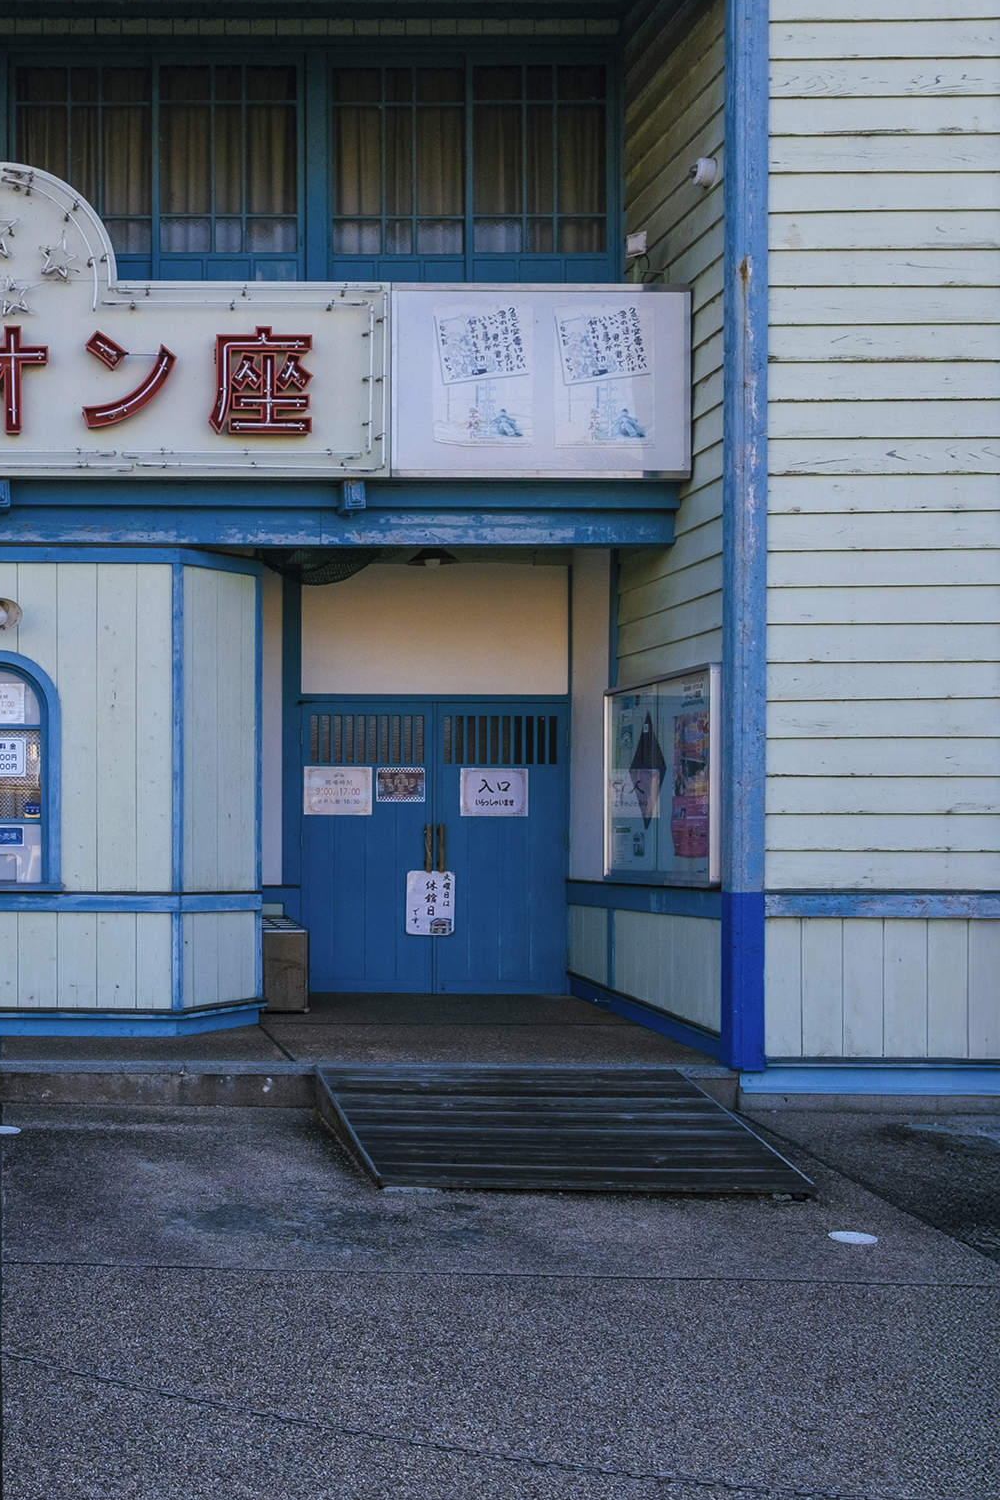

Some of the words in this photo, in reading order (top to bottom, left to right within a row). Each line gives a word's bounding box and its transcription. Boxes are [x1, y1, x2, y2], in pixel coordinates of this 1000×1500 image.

[478, 779, 511, 794] 入口
[475, 799, 515, 807] いらっしゃいませ
[424, 879, 438, 916] 休館日
[442, 873, 451, 907] 火曜日は
